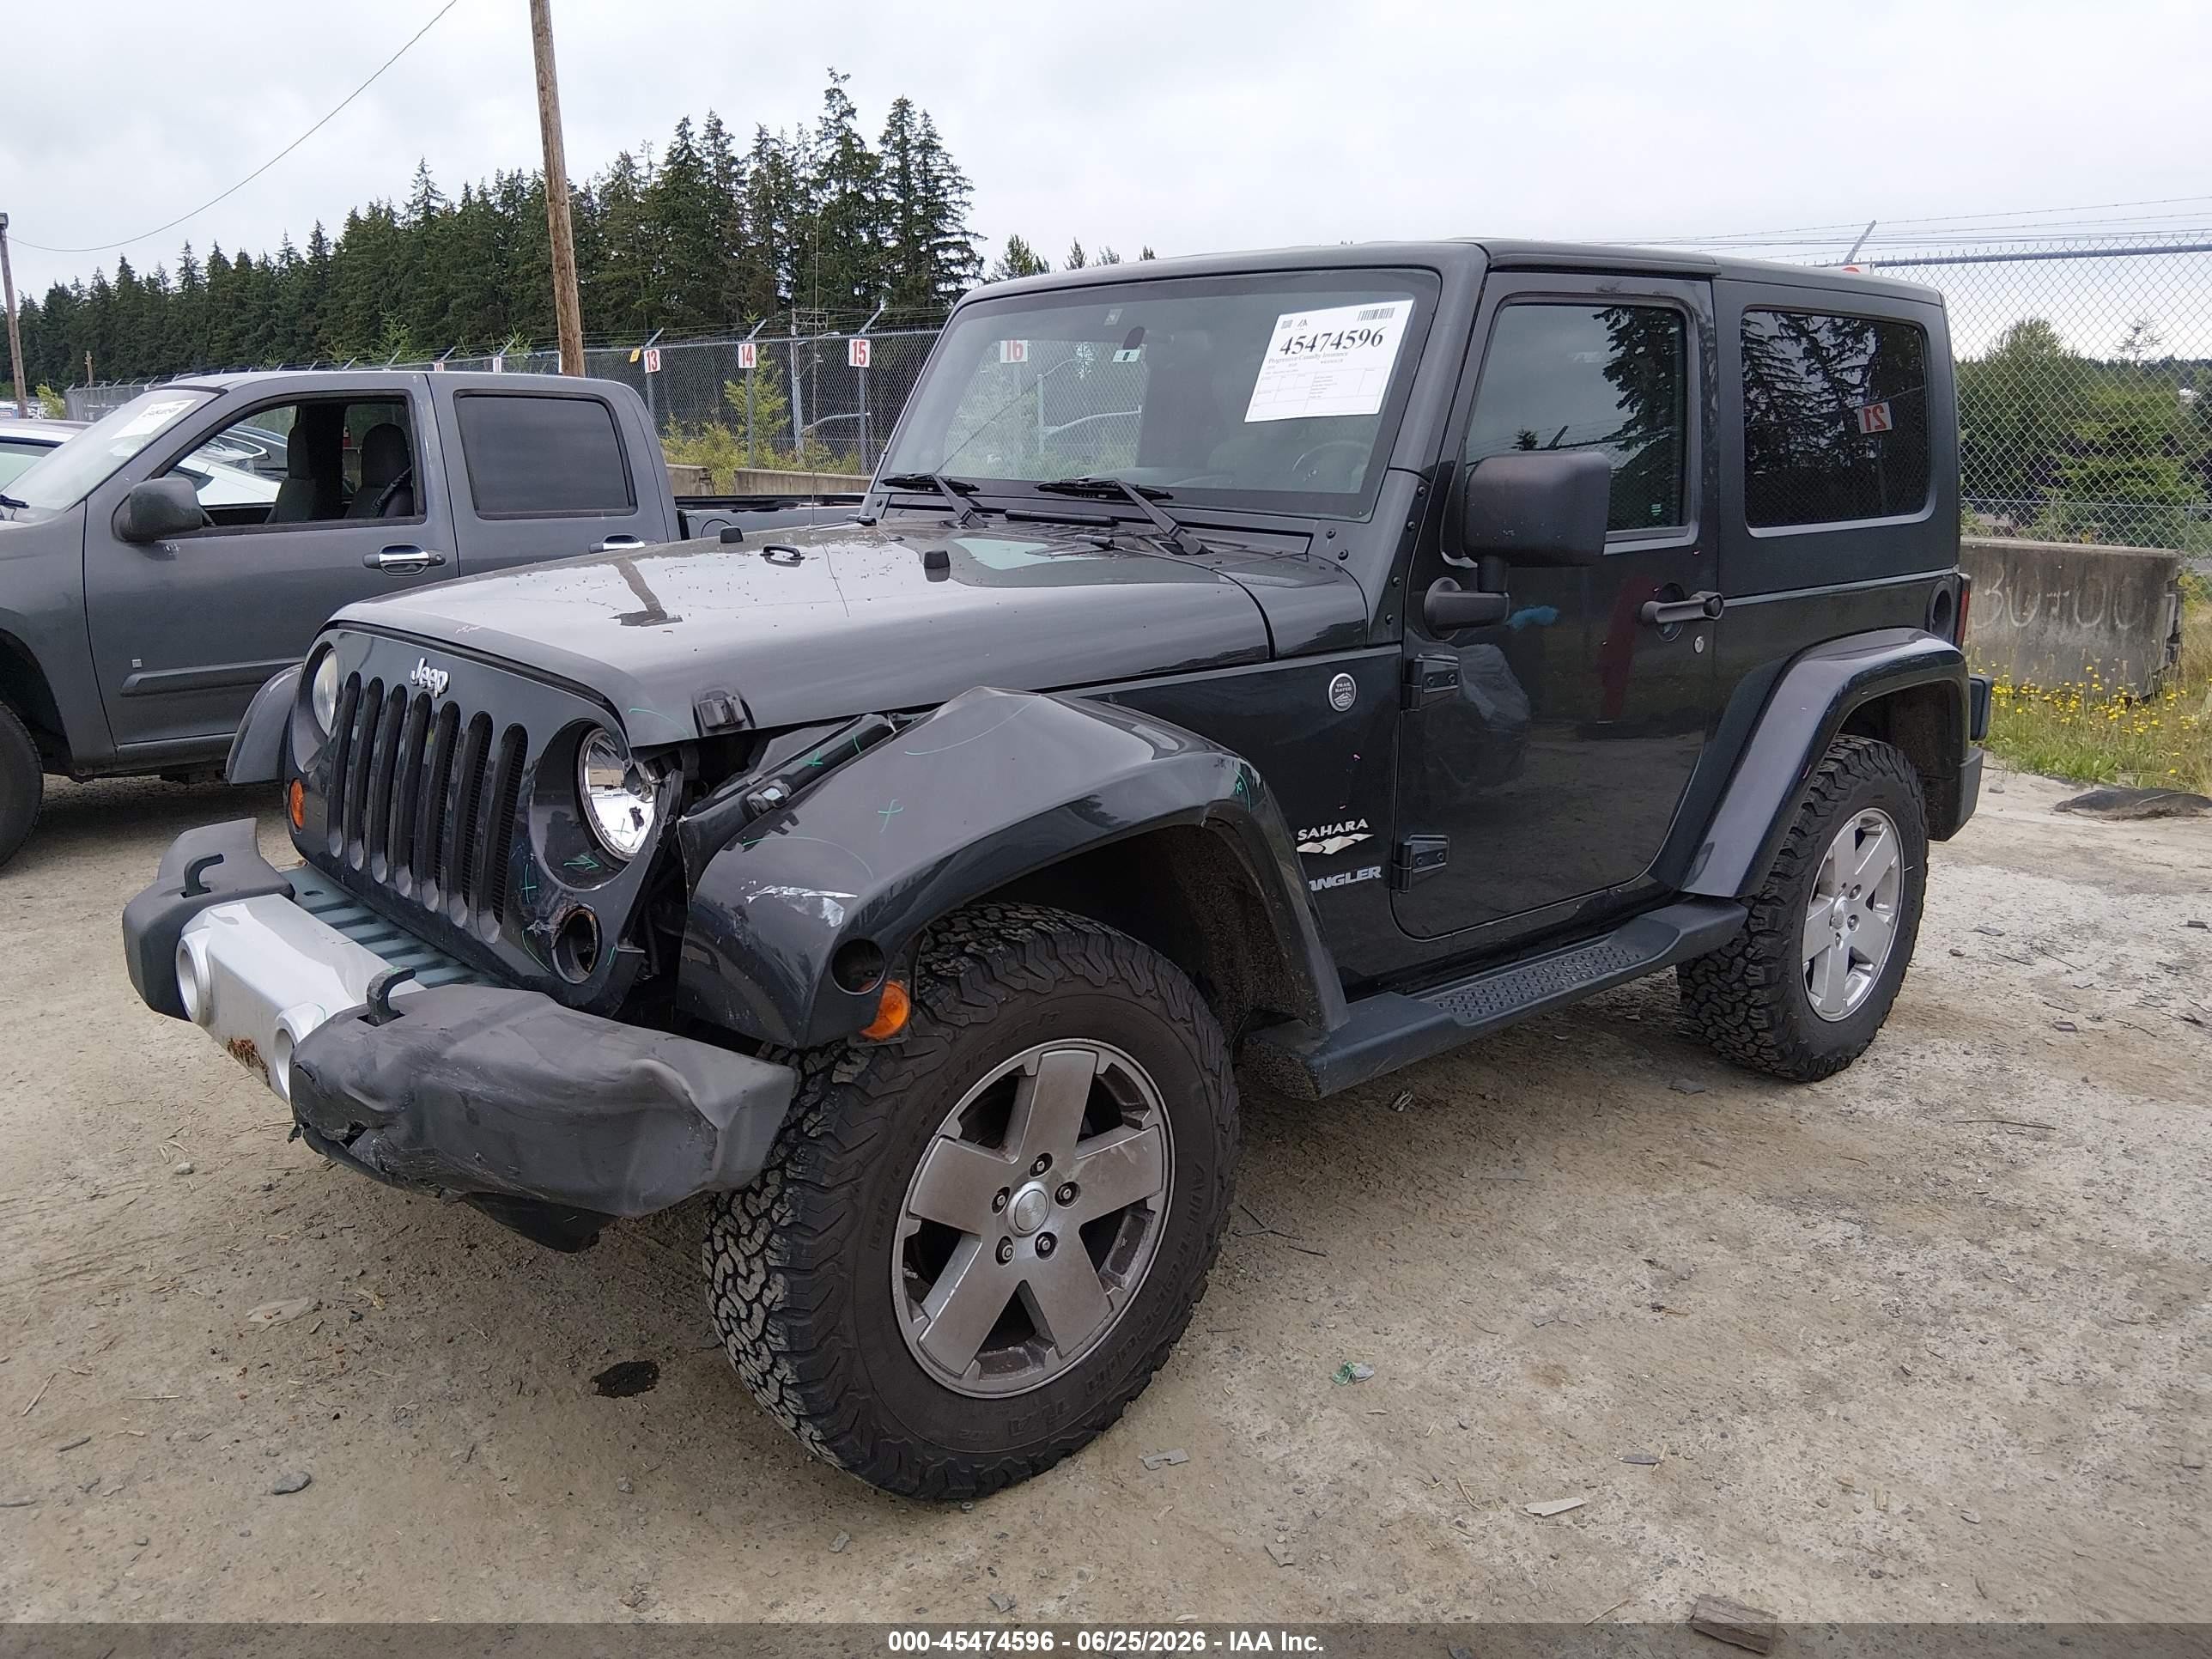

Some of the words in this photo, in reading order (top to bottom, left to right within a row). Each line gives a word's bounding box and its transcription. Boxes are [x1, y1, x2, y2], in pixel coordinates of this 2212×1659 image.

[1279, 326, 1387, 355] 45474596
[647, 350, 658, 372] 13
[742, 345, 753, 367] 14
[853, 341, 866, 365] 15
[410, 658, 449, 698] Jeep
[1297, 817, 1370, 841] SAHARA
